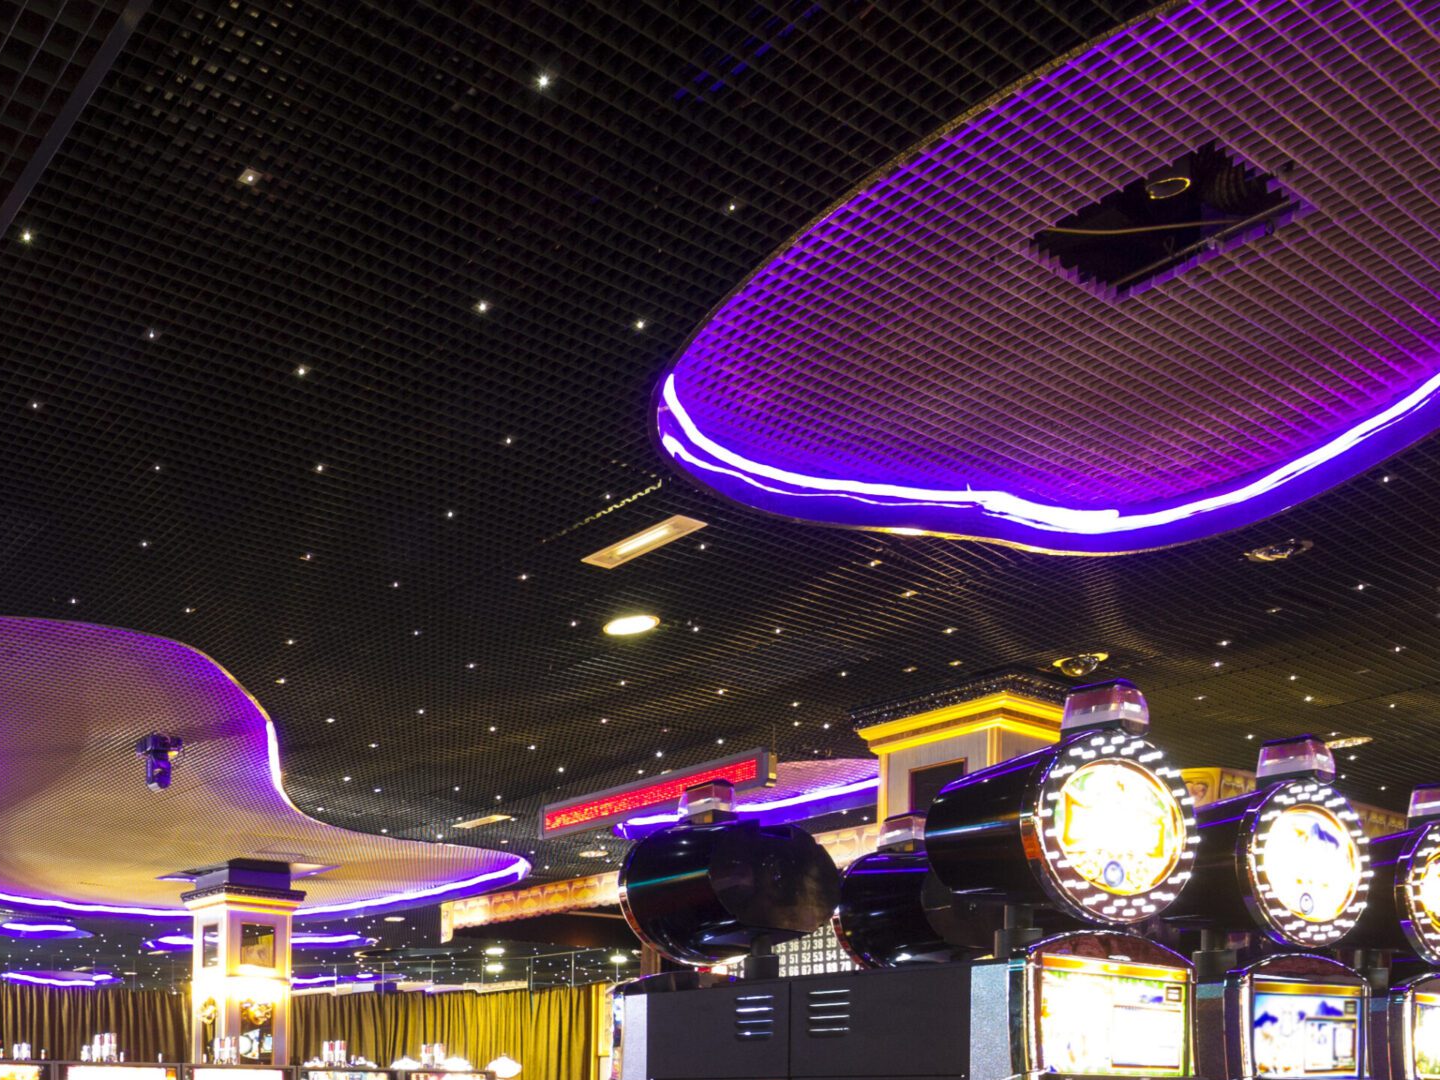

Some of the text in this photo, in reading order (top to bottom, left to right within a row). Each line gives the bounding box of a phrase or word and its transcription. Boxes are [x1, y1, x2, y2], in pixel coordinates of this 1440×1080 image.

[801, 940, 811, 951] 37
[813, 938, 824, 949] 38
[826, 937, 837, 948] 39
[789, 953, 799, 964] 51
[801, 952, 811, 963] 52
[813, 950, 824, 962] 53
[826, 949, 837, 961] 54
